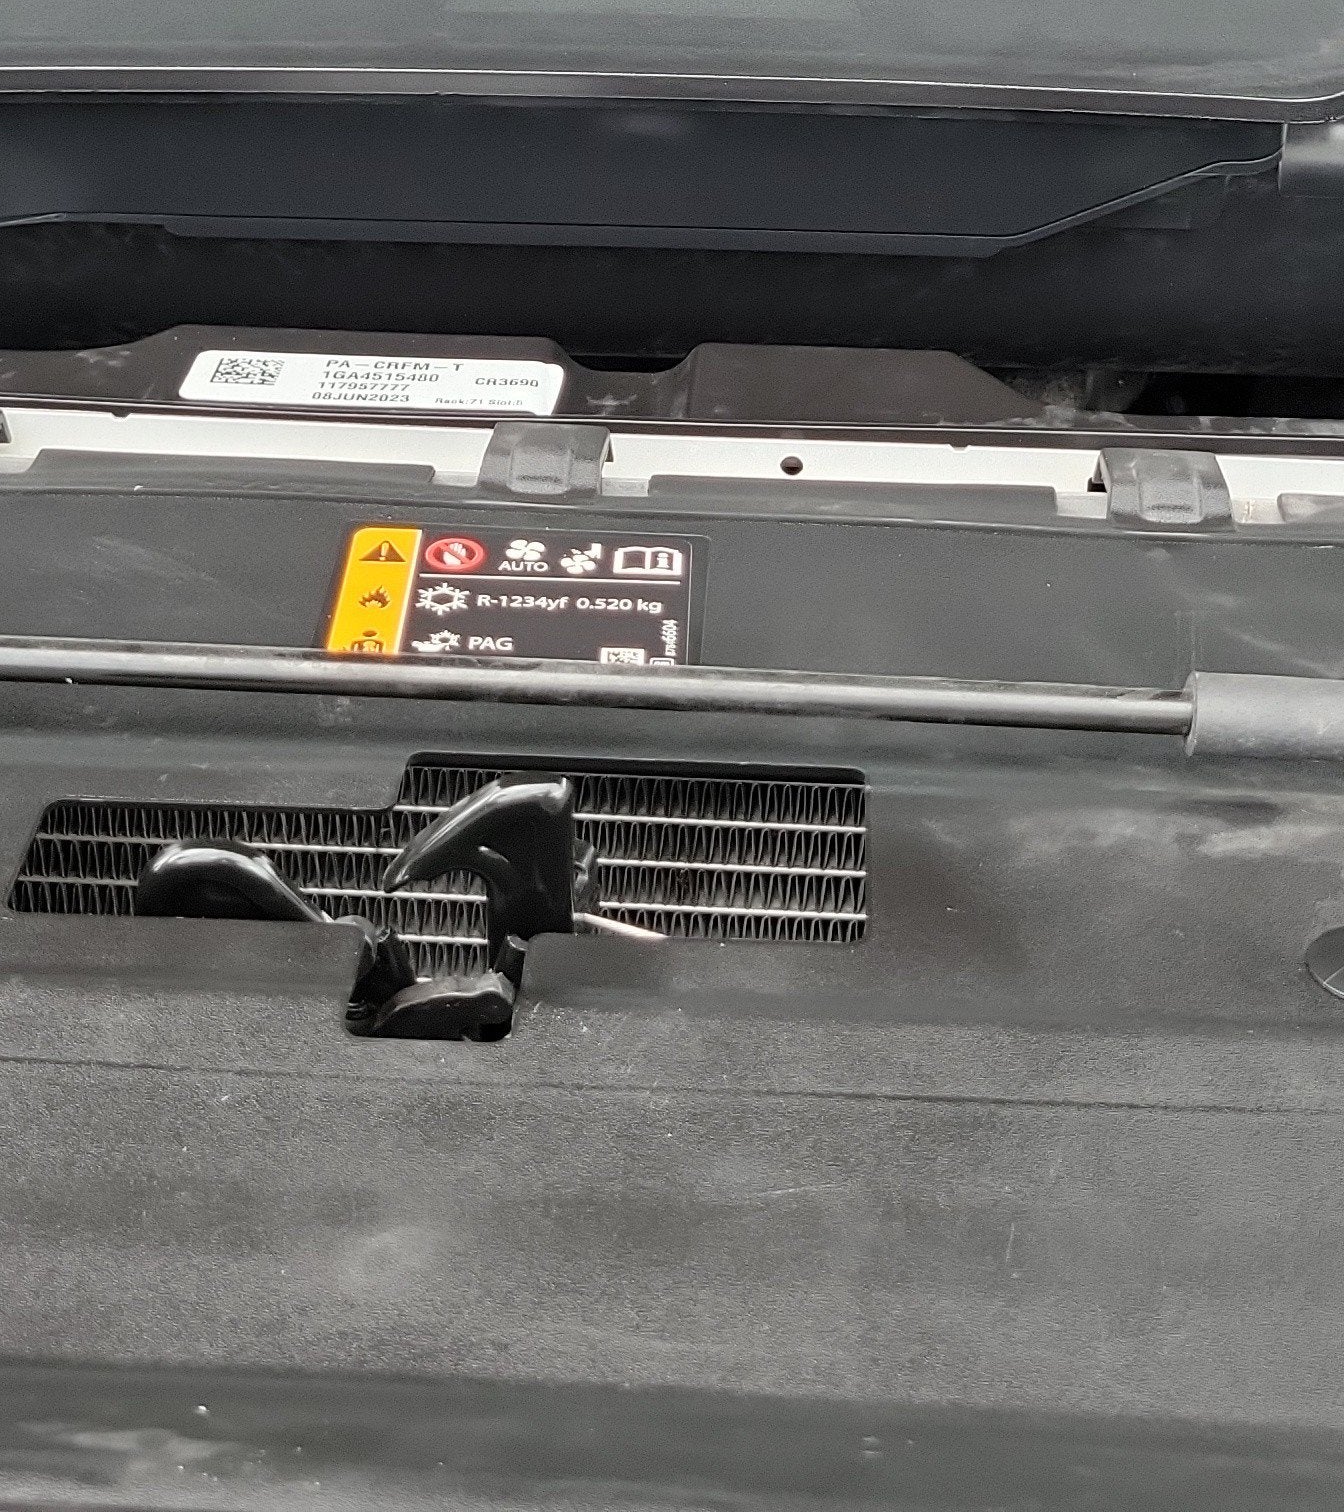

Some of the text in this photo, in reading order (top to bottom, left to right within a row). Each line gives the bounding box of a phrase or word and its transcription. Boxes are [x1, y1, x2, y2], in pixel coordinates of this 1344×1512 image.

[311, 391, 410, 403] 08JUN2023
[498, 560, 549, 573] AUTO
[476, 594, 663, 615] R-1234yf 0.520 kg
[468, 635, 514, 651] PAG
